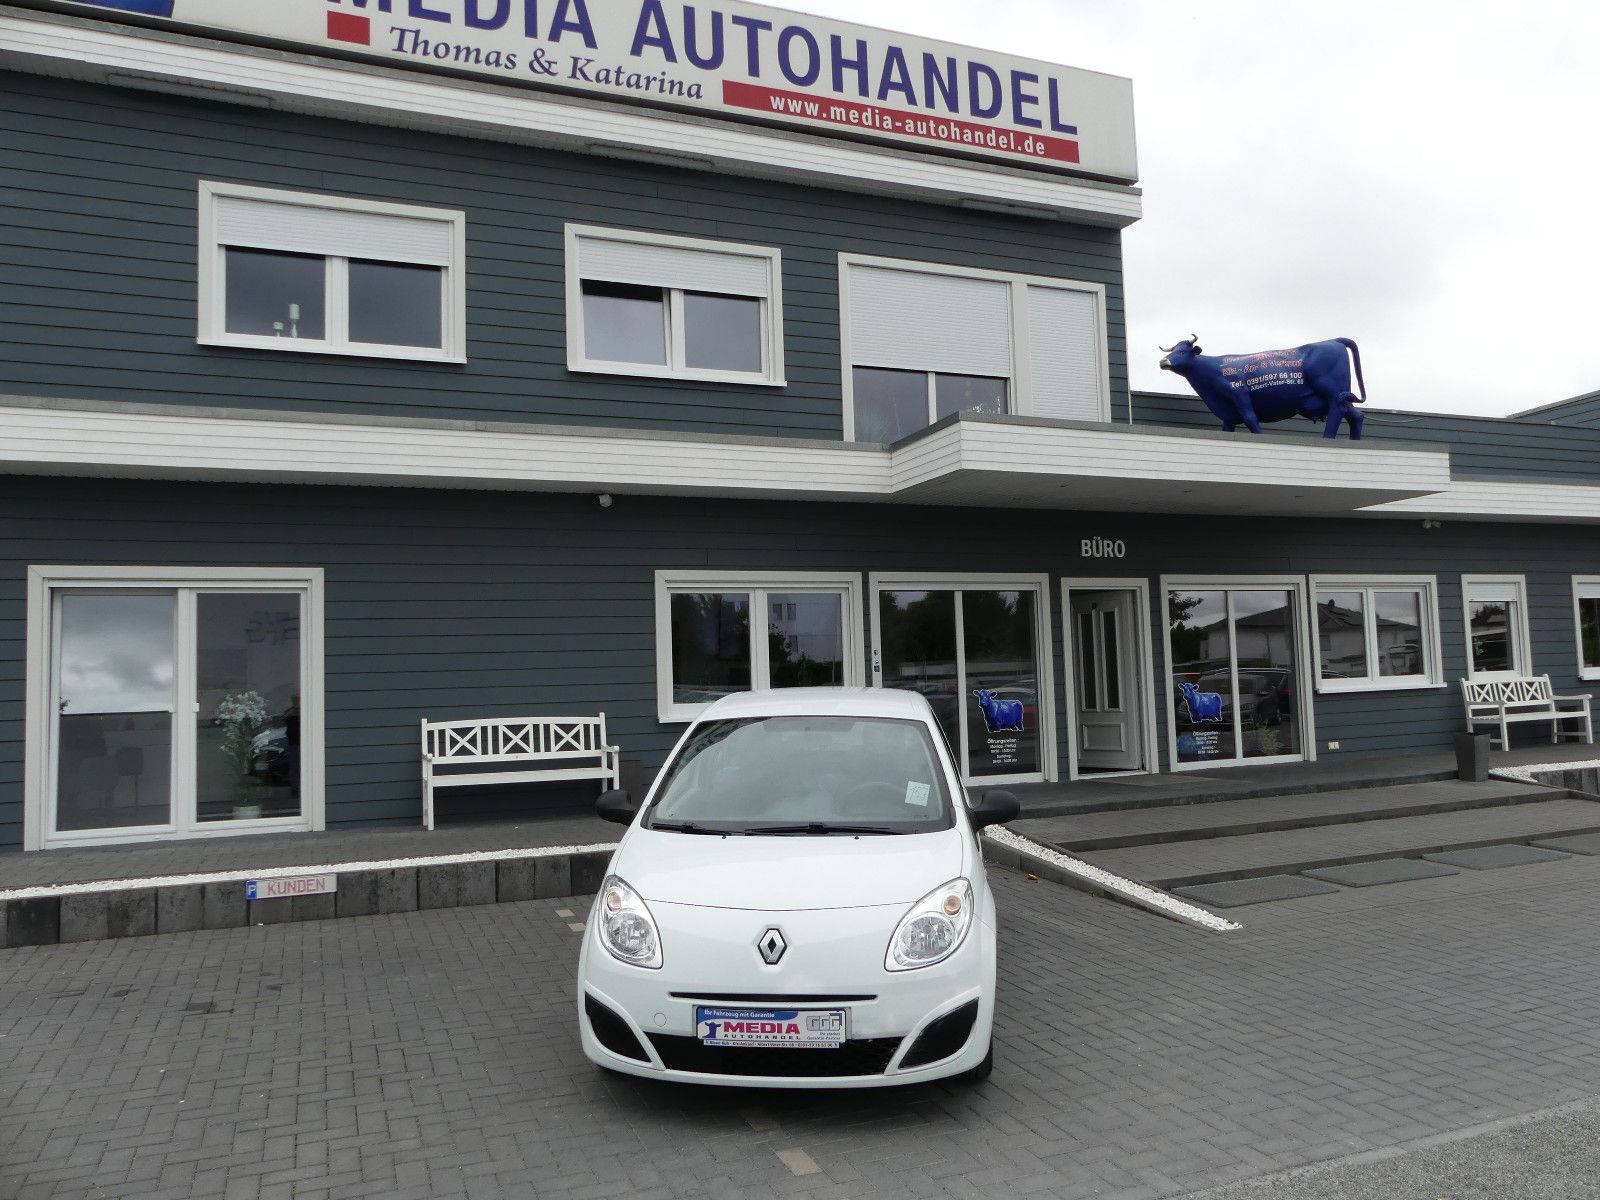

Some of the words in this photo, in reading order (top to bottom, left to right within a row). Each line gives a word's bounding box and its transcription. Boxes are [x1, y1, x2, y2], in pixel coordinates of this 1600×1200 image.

[327, 0, 599, 50] DIA
[629, 0, 1078, 136] AUTOHANDEL
[389, 27, 518, 71] Thomas
[528, 47, 560, 76] &
[566, 55, 703, 99] Katarina
[769, 95, 1046, 156] www.media-autohandel.de
[1246, 373, 1277, 386] 0391/597
[1081, 536, 1126, 558] BÜRO
[267, 878, 326, 896] KUNDEN
[713, 1010, 739, 1018] Fahrzeug
[724, 1021, 800, 1034] MEDIA
